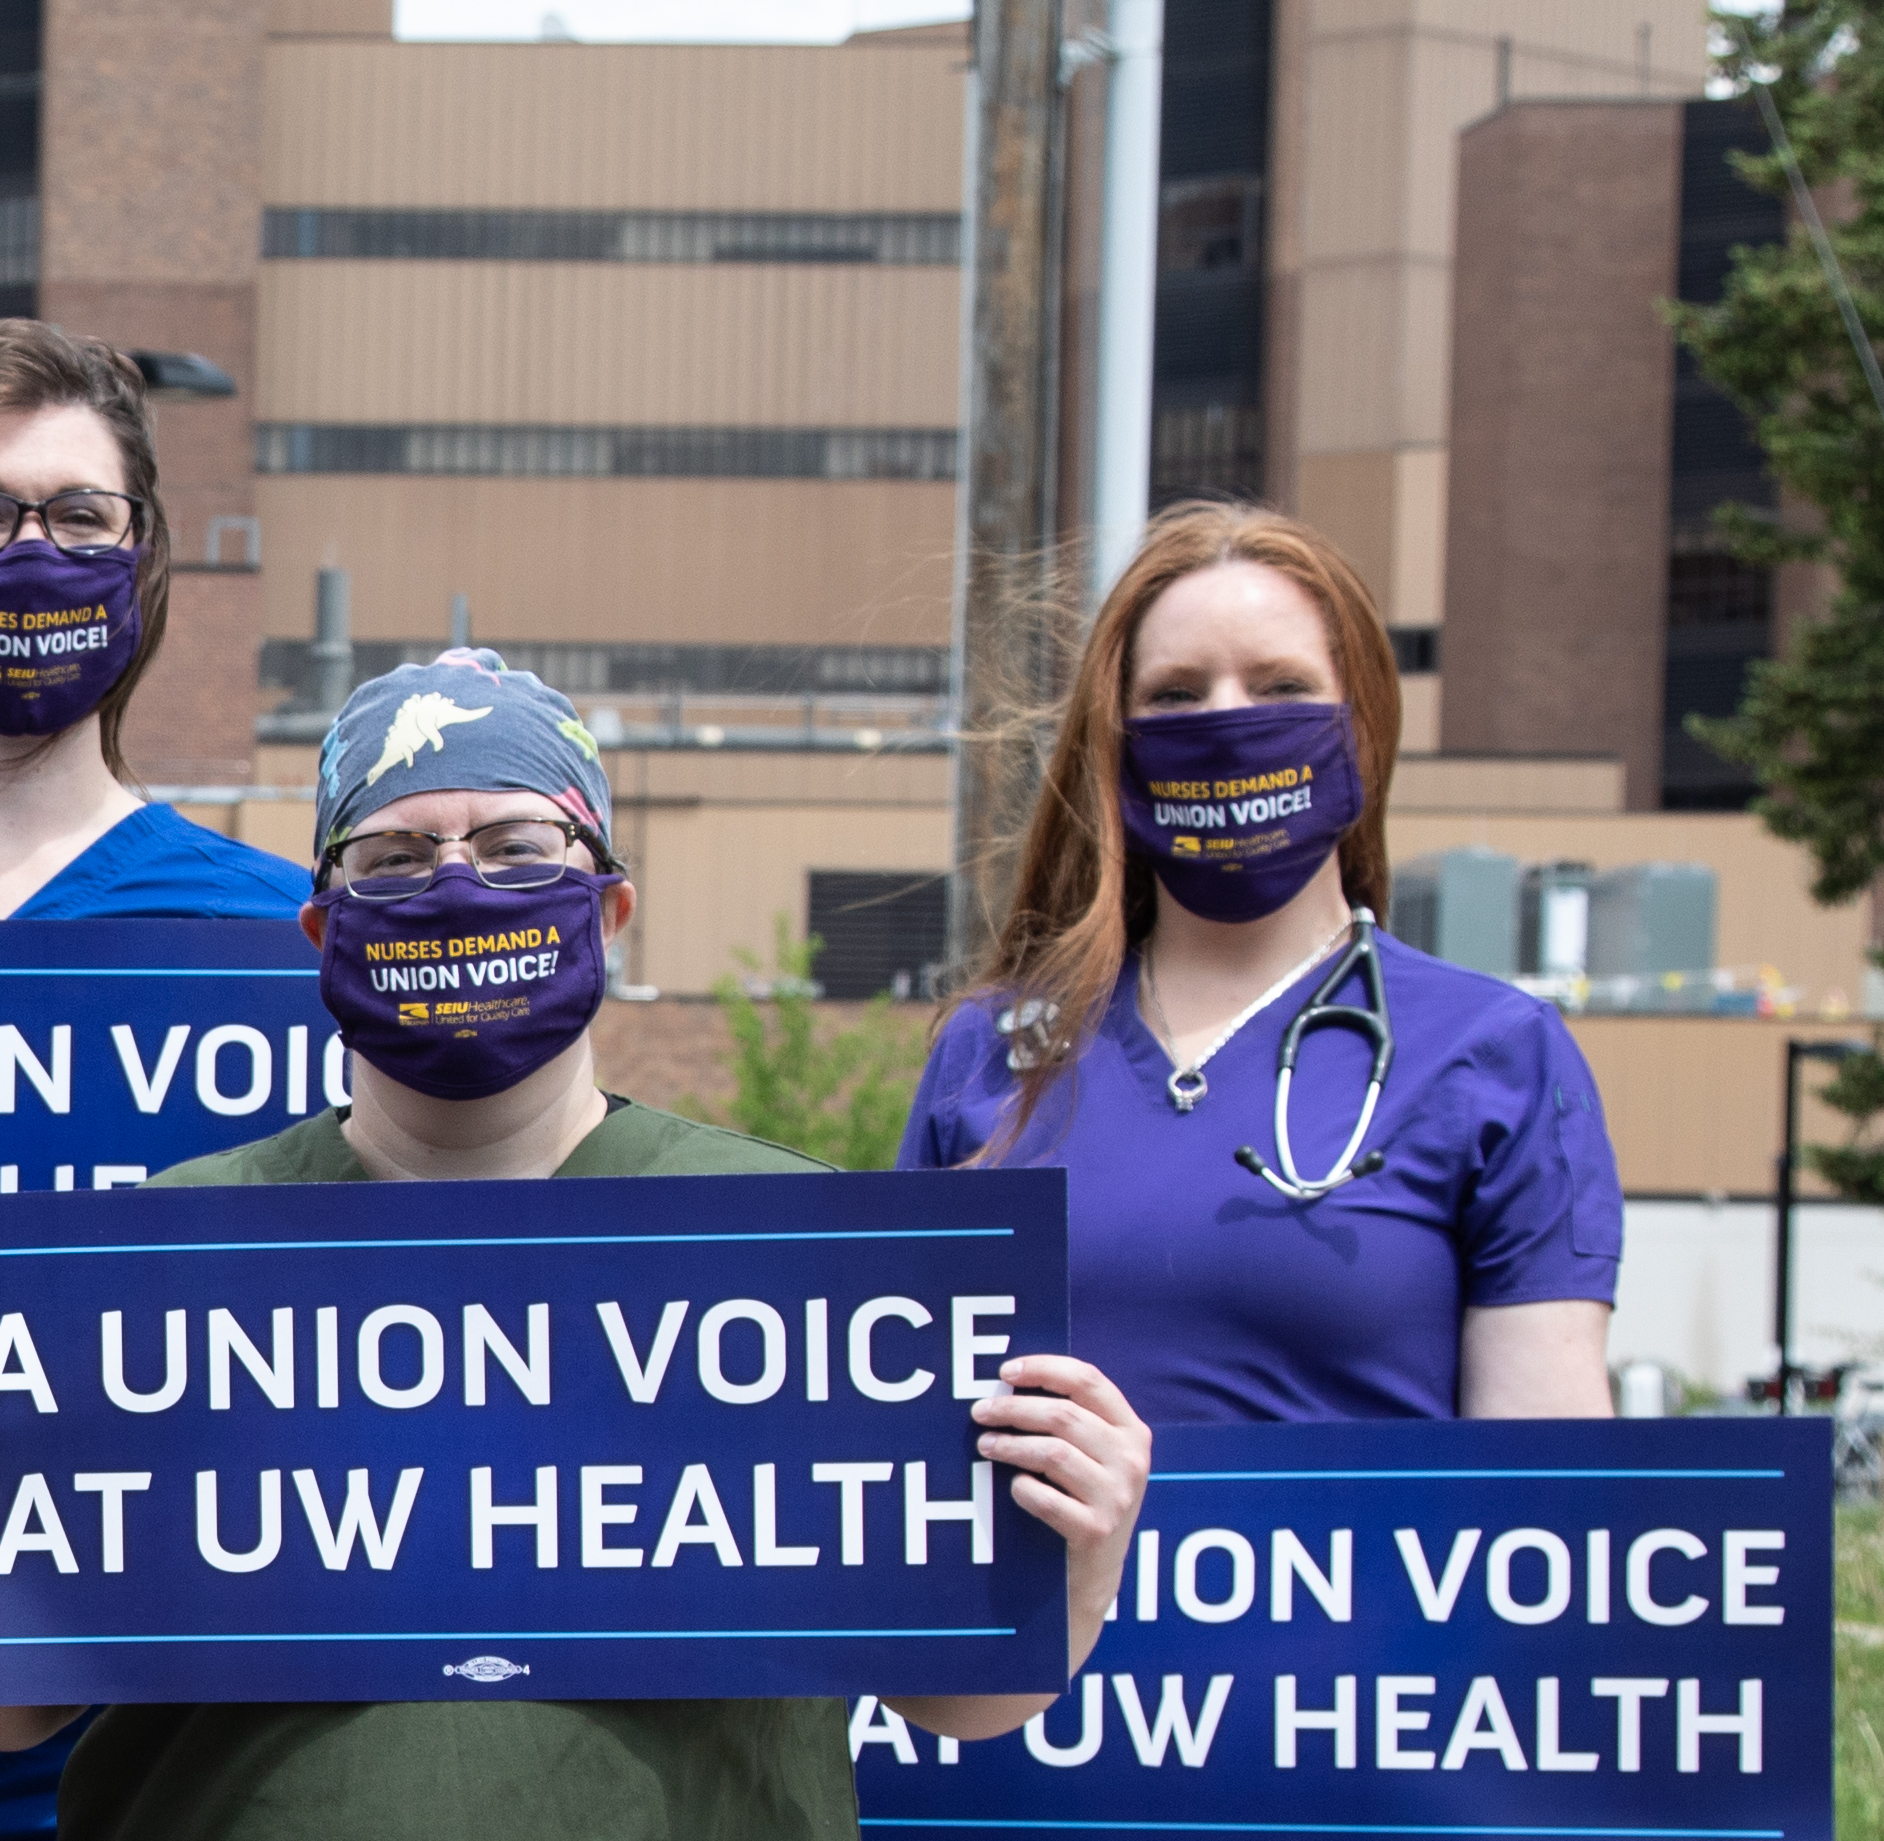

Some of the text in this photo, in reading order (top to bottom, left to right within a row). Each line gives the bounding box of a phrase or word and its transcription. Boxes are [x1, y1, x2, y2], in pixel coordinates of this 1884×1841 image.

[22, 607, 91, 630] DEMAND
[95, 604, 107, 620] A
[36, 625, 108, 656] VOICE!
[1149, 765, 1313, 799] NURSES DEMAND A
[1154, 785, 1313, 828] UNION VOICE!
[366, 925, 560, 961] NURSES DEMAND A
[370, 951, 559, 991] UNION VOICE!
[100, 1302, 551, 1410] UNION
[596, 1294, 1016, 1404] VOICE
[195, 1466, 425, 1573] UW
[470, 1459, 993, 1569] HEALTH
[1106, 1528, 1785, 1626] ION VOICE
[1023, 1672, 1234, 1768] UW
[1274, 1674, 1762, 1773] HEALTH
